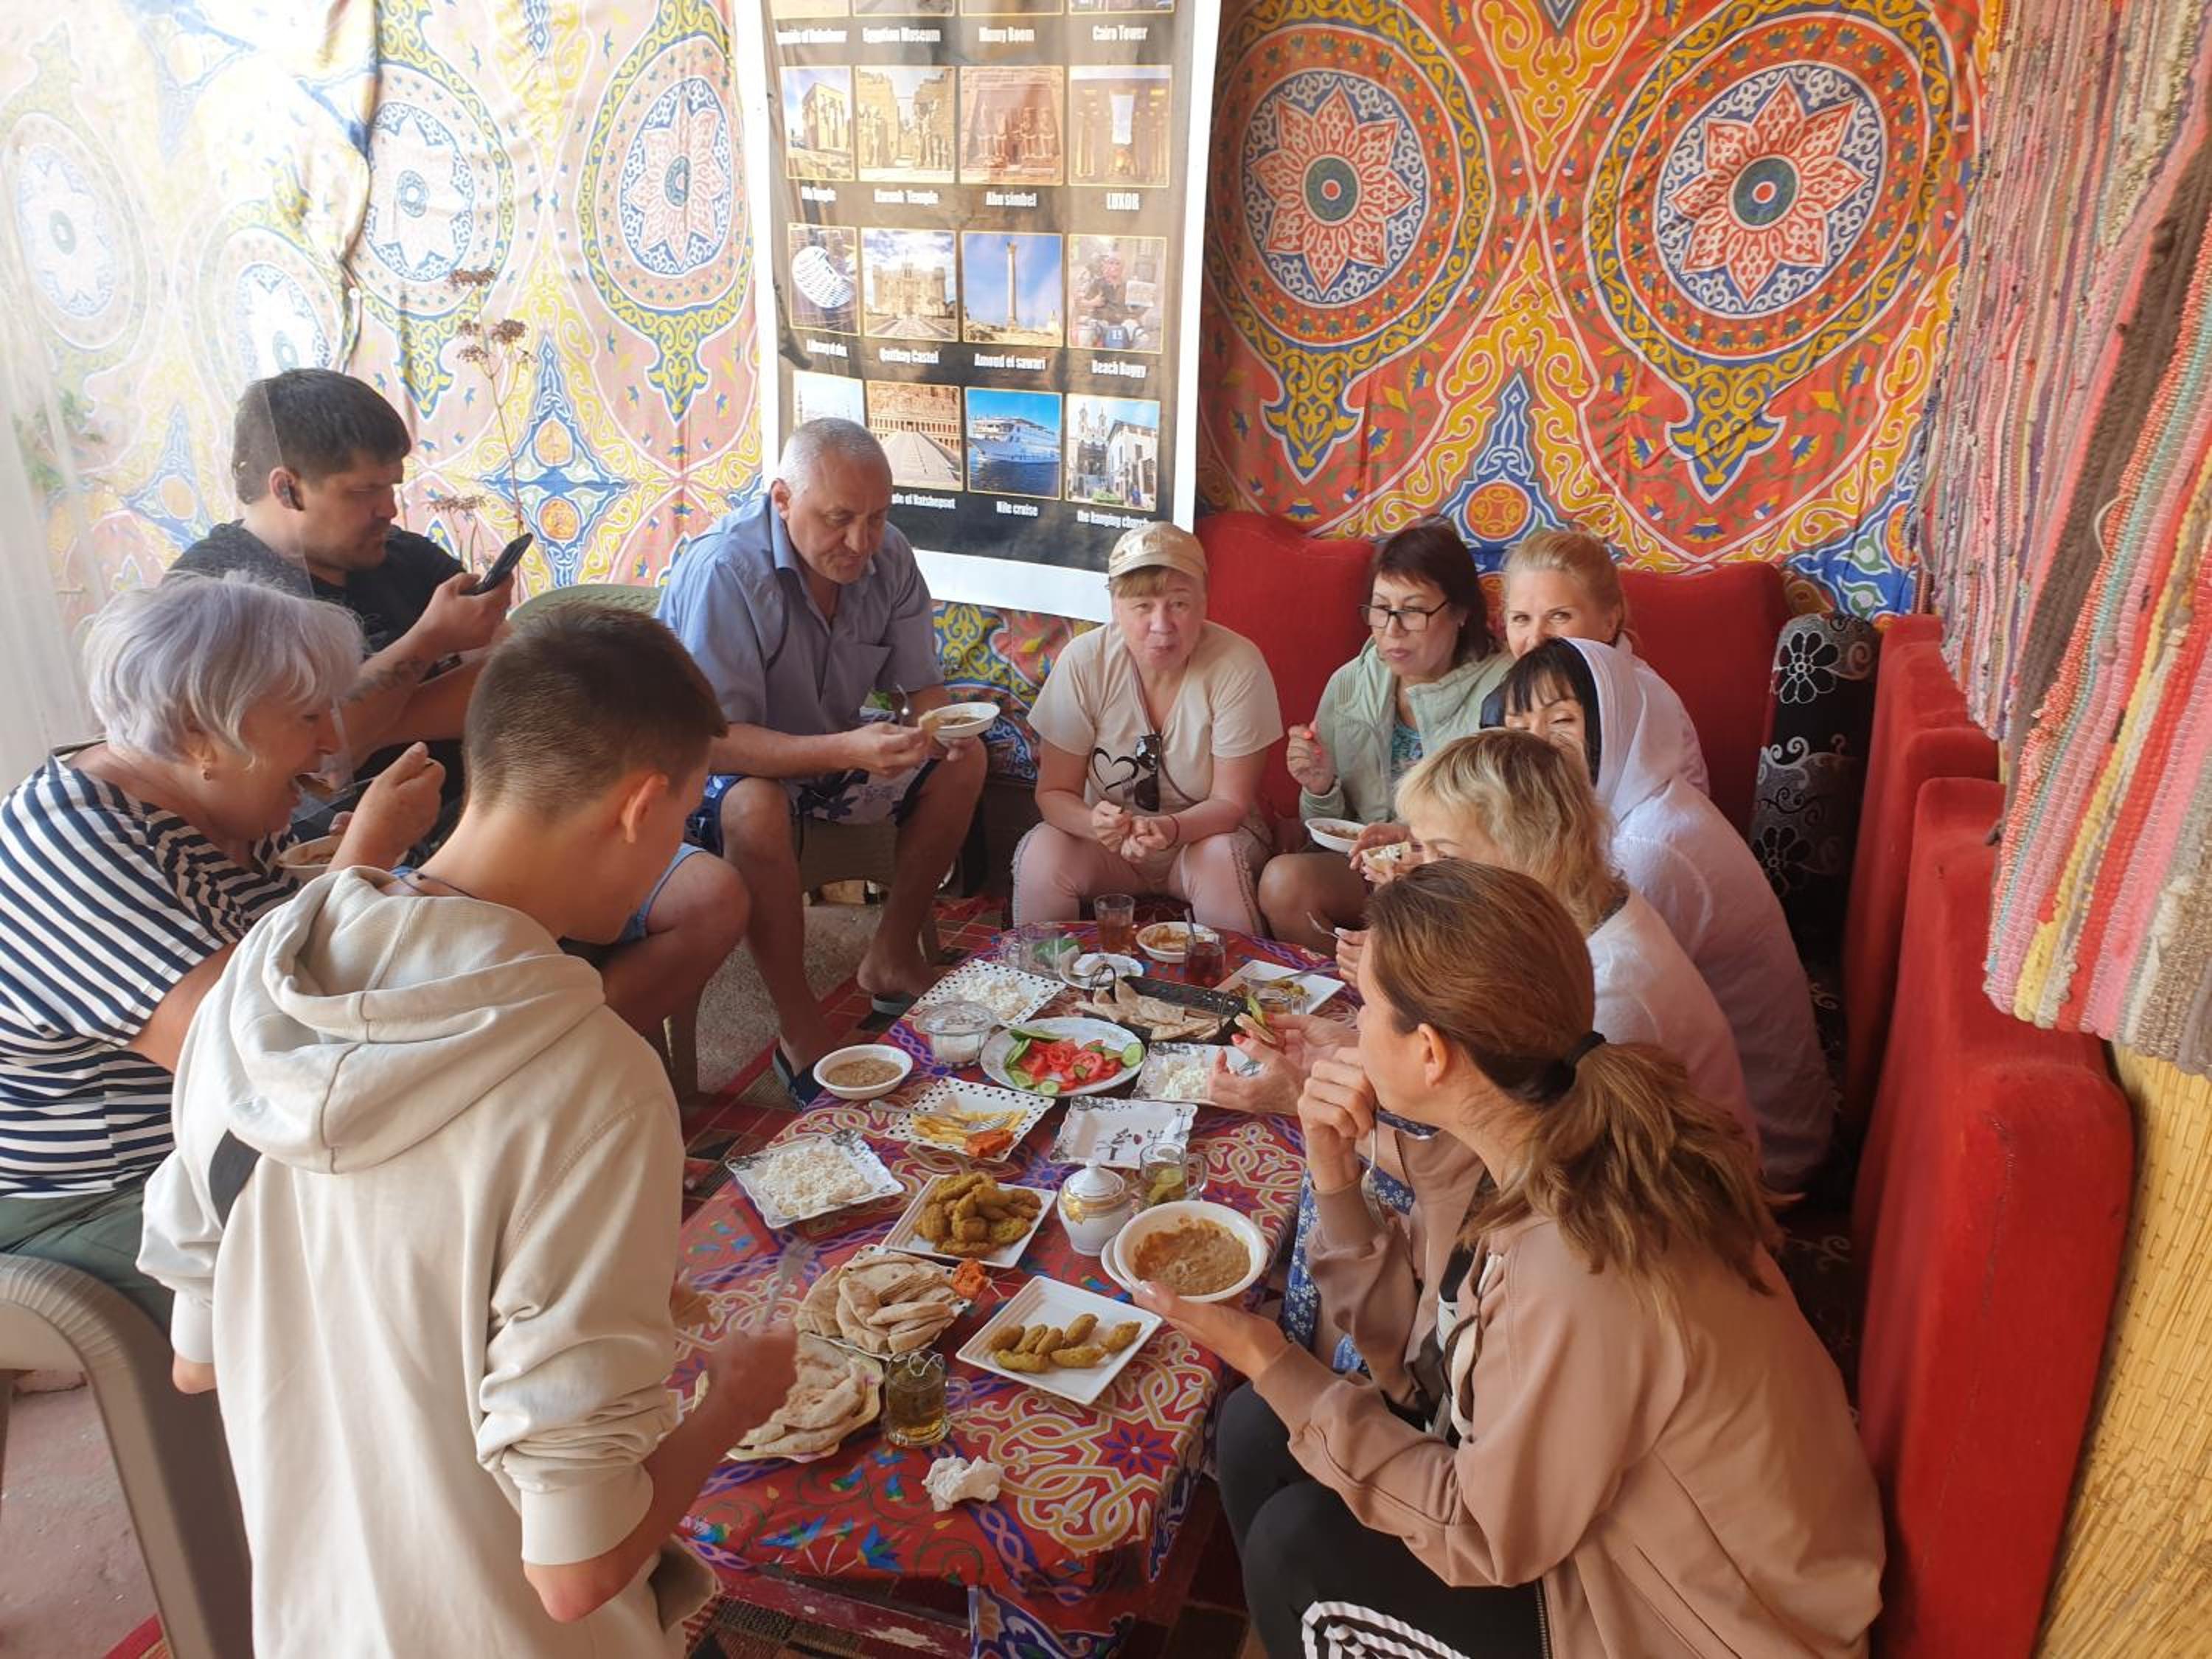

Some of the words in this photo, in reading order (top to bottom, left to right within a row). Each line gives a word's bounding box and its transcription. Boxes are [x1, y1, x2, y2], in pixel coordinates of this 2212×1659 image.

[1092, 25, 1117, 41] Cairo
[1118, 24, 1148, 41] Tower
[906, 189, 939, 205] Temple
[1107, 192, 1139, 210] LUXOR
[1006, 355, 1015, 368] el
[1091, 360, 1119, 375] Beach
[996, 501, 1012, 515] Nile
[1013, 504, 1038, 517] cruise
[1077, 509, 1090, 523] the
